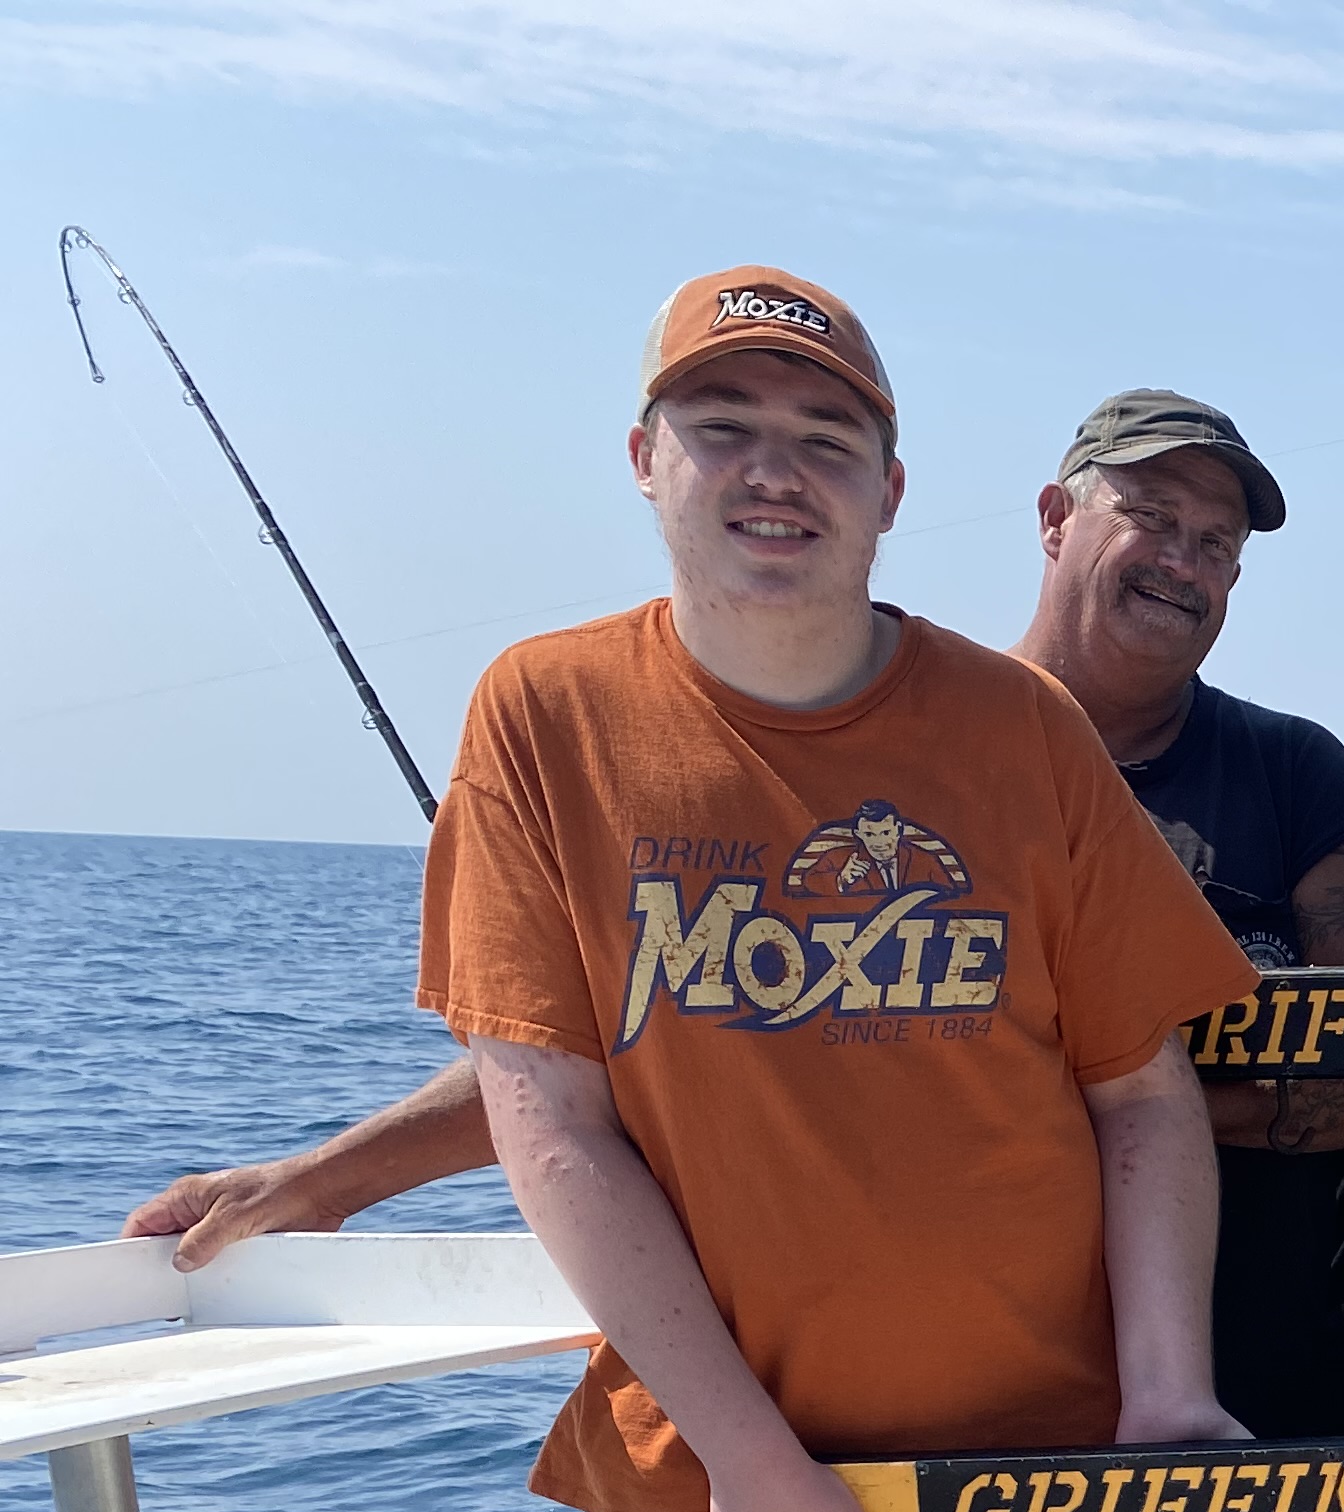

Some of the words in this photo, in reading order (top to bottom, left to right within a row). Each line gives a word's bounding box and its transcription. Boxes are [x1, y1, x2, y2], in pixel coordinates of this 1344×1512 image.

[711, 290, 827, 332] MOXIE
[629, 836, 772, 871] DRINK
[615, 880, 1006, 1048] MOXIE
[821, 1018, 911, 1046] SINCE
[927, 1015, 993, 1042] 1884
